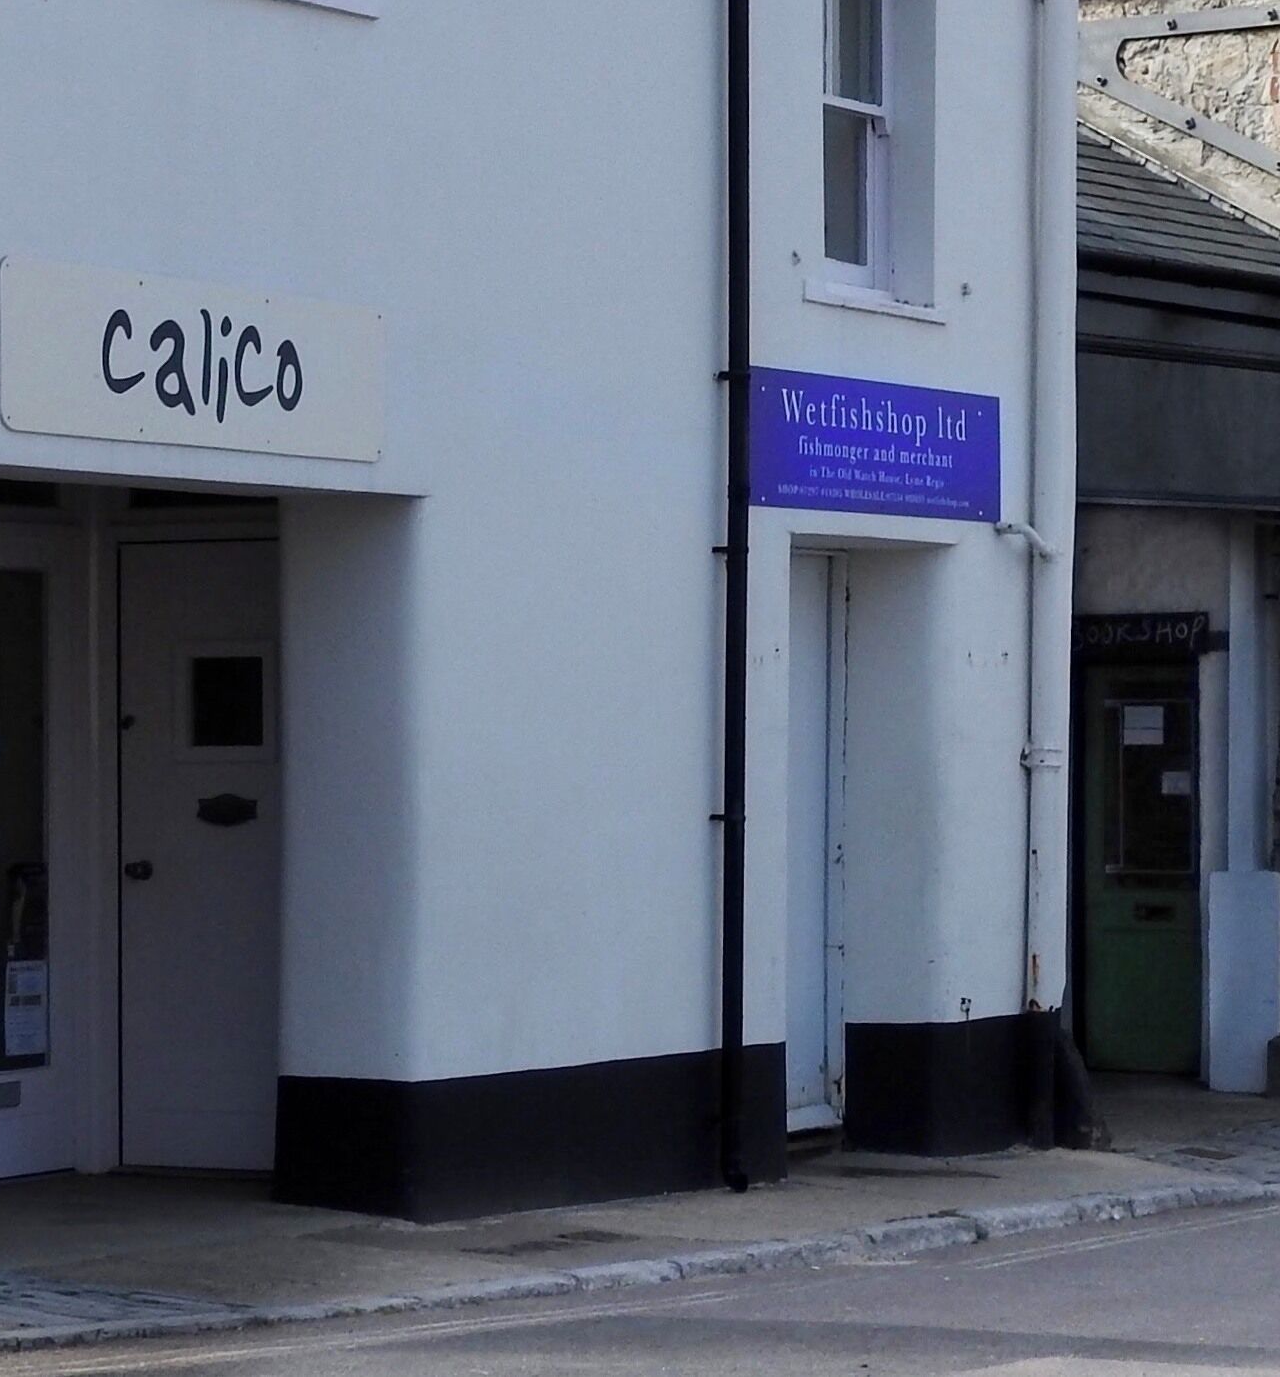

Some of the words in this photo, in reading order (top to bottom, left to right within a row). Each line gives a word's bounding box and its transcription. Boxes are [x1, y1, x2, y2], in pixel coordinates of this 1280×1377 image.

[781, 388, 927, 447] Wetfishshop
[937, 406, 967, 442] ltd
[798, 435, 869, 465] fishmonger
[873, 444, 895, 463] and
[900, 447, 953, 469] merchant
